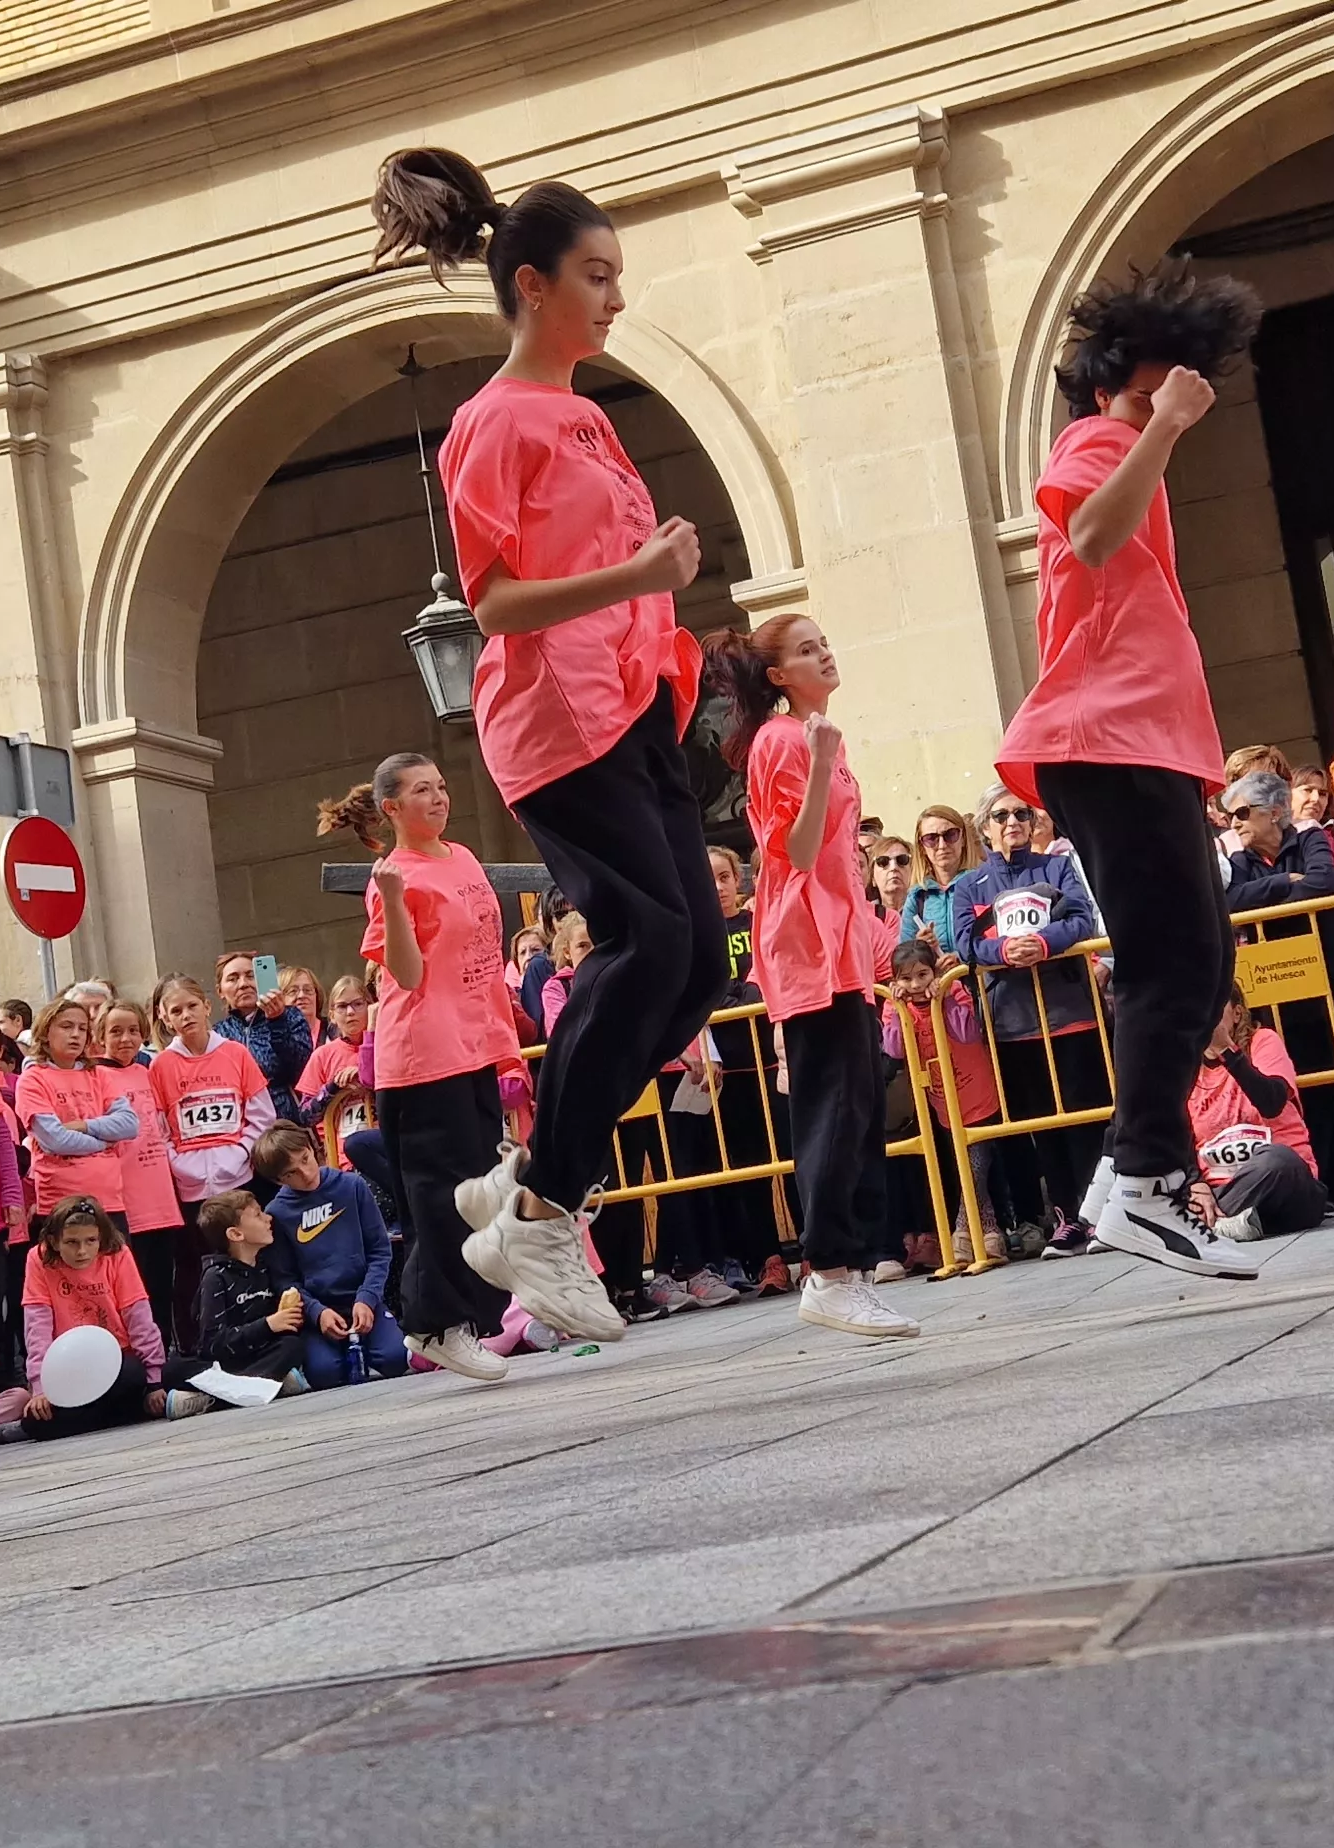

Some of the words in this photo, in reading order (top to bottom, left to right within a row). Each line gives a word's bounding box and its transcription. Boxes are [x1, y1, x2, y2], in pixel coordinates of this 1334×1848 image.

[1007, 909, 1040, 931] 900
[1254, 955, 1319, 975] Ayuntamiento
[1256, 976, 1268, 985] de
[1269, 970, 1306, 982] Huesca
[184, 1104, 234, 1126] 1437
[302, 1202, 333, 1230] NIKE
